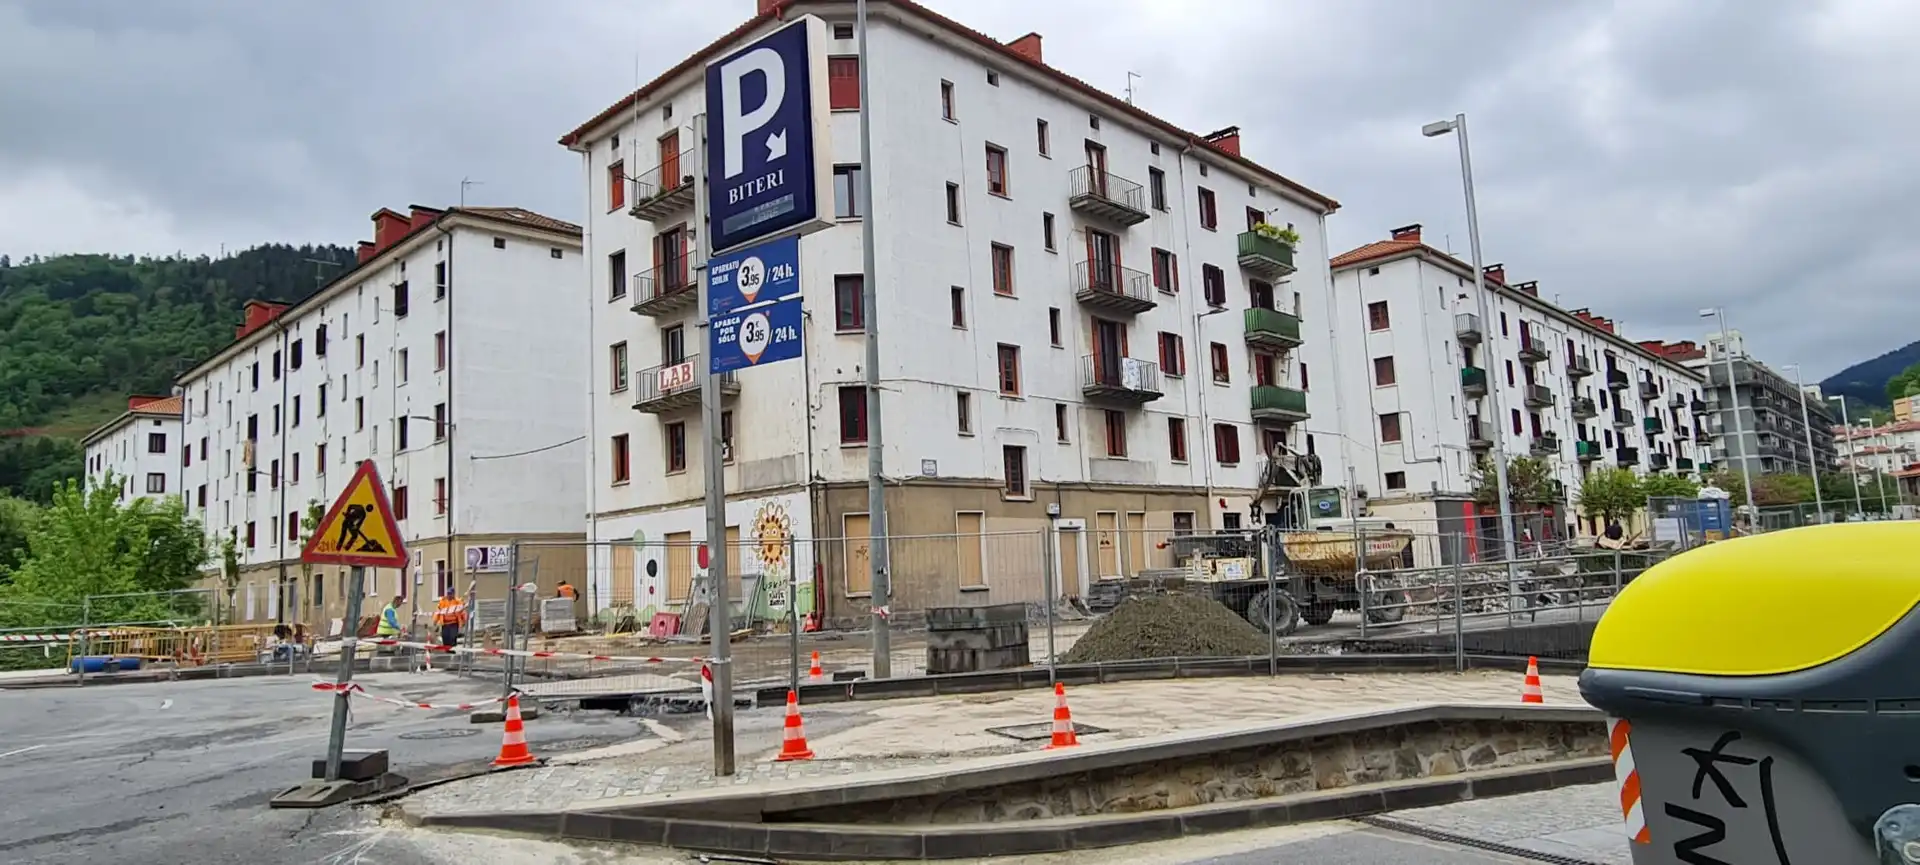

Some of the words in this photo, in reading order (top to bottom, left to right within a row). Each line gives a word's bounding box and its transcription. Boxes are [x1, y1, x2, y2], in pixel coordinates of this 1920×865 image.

[720, 48, 786, 180] P
[729, 169, 785, 205] BITERI
[711, 260, 740, 276] APARKATU
[772, 264, 785, 281] 24
[713, 316, 741, 329] APARCA
[720, 326, 735, 336] POR
[775, 326, 788, 343] 24
[659, 363, 692, 390] LAB
